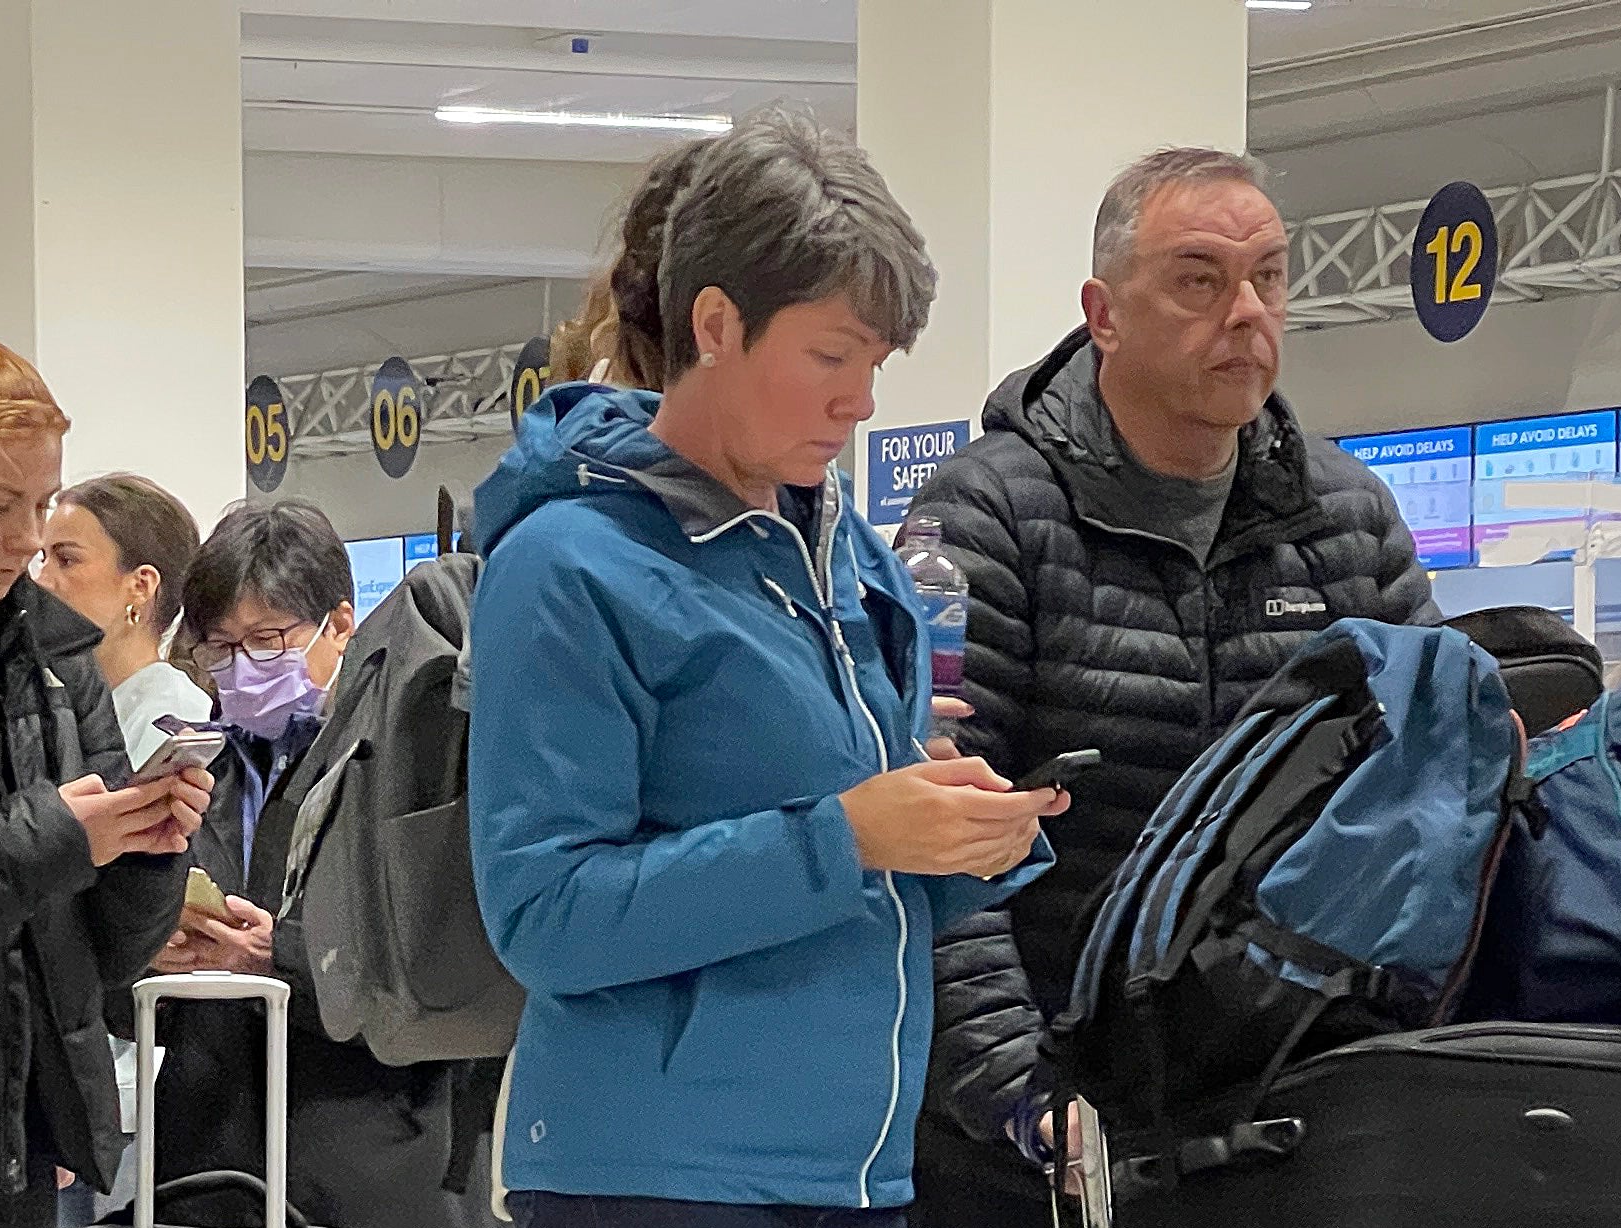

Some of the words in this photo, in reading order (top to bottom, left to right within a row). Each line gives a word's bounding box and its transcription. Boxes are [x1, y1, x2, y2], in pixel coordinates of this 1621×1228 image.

[1426, 221, 1483, 304] 12
[516, 367, 551, 418] 0
[246, 403, 286, 465] 05
[373, 387, 418, 450] 06
[1492, 432, 1518, 447] HELP
[1519, 428, 1556, 444] AVOID
[1557, 423, 1598, 440] DELAYS
[881, 437, 911, 463] FOR
[913, 430, 956, 459] YOUR
[1353, 447, 1379, 461] HELP
[1380, 443, 1415, 459] AVOID
[1415, 439, 1454, 455] DELAYS
[892, 462, 938, 491] SAFET
